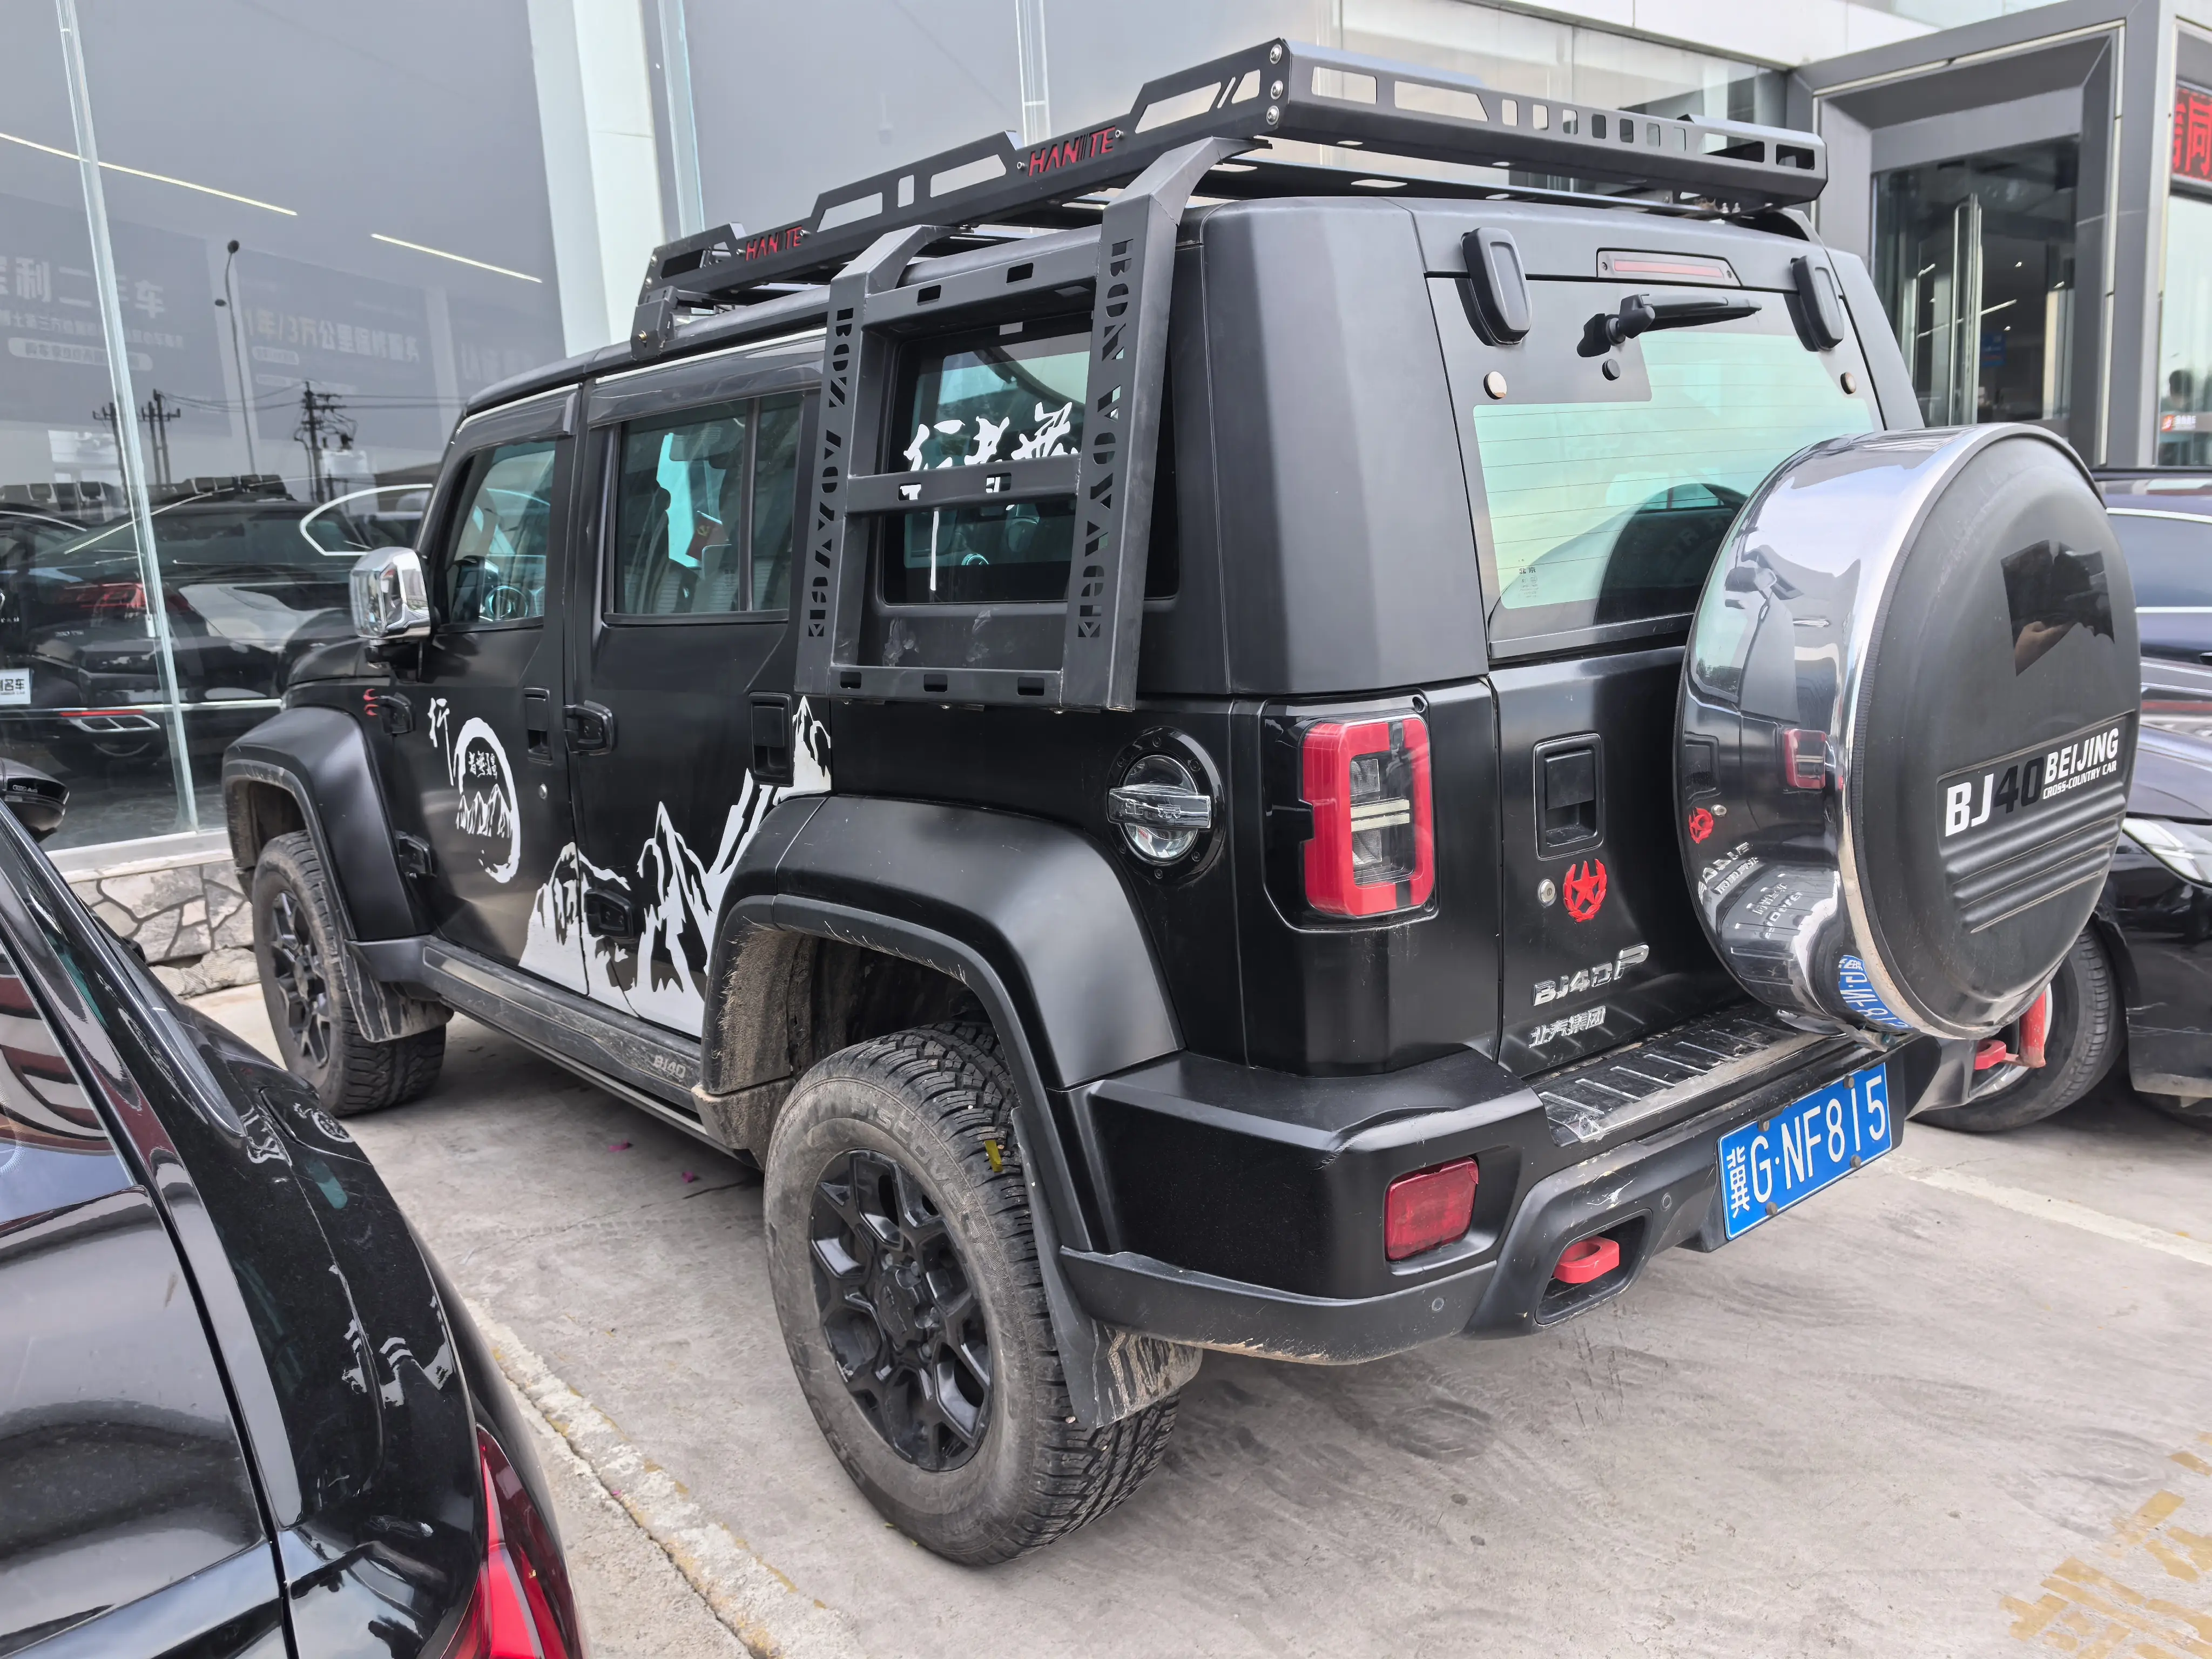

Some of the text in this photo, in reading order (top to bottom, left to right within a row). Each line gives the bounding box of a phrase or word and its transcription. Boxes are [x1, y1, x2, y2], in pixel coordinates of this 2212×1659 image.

[0, 255, 165, 319] 利二车
[1945, 727, 2119, 837] BJ40 BEIJING
[2042, 760, 2117, 800] CROSS-COUNTRY CAR
